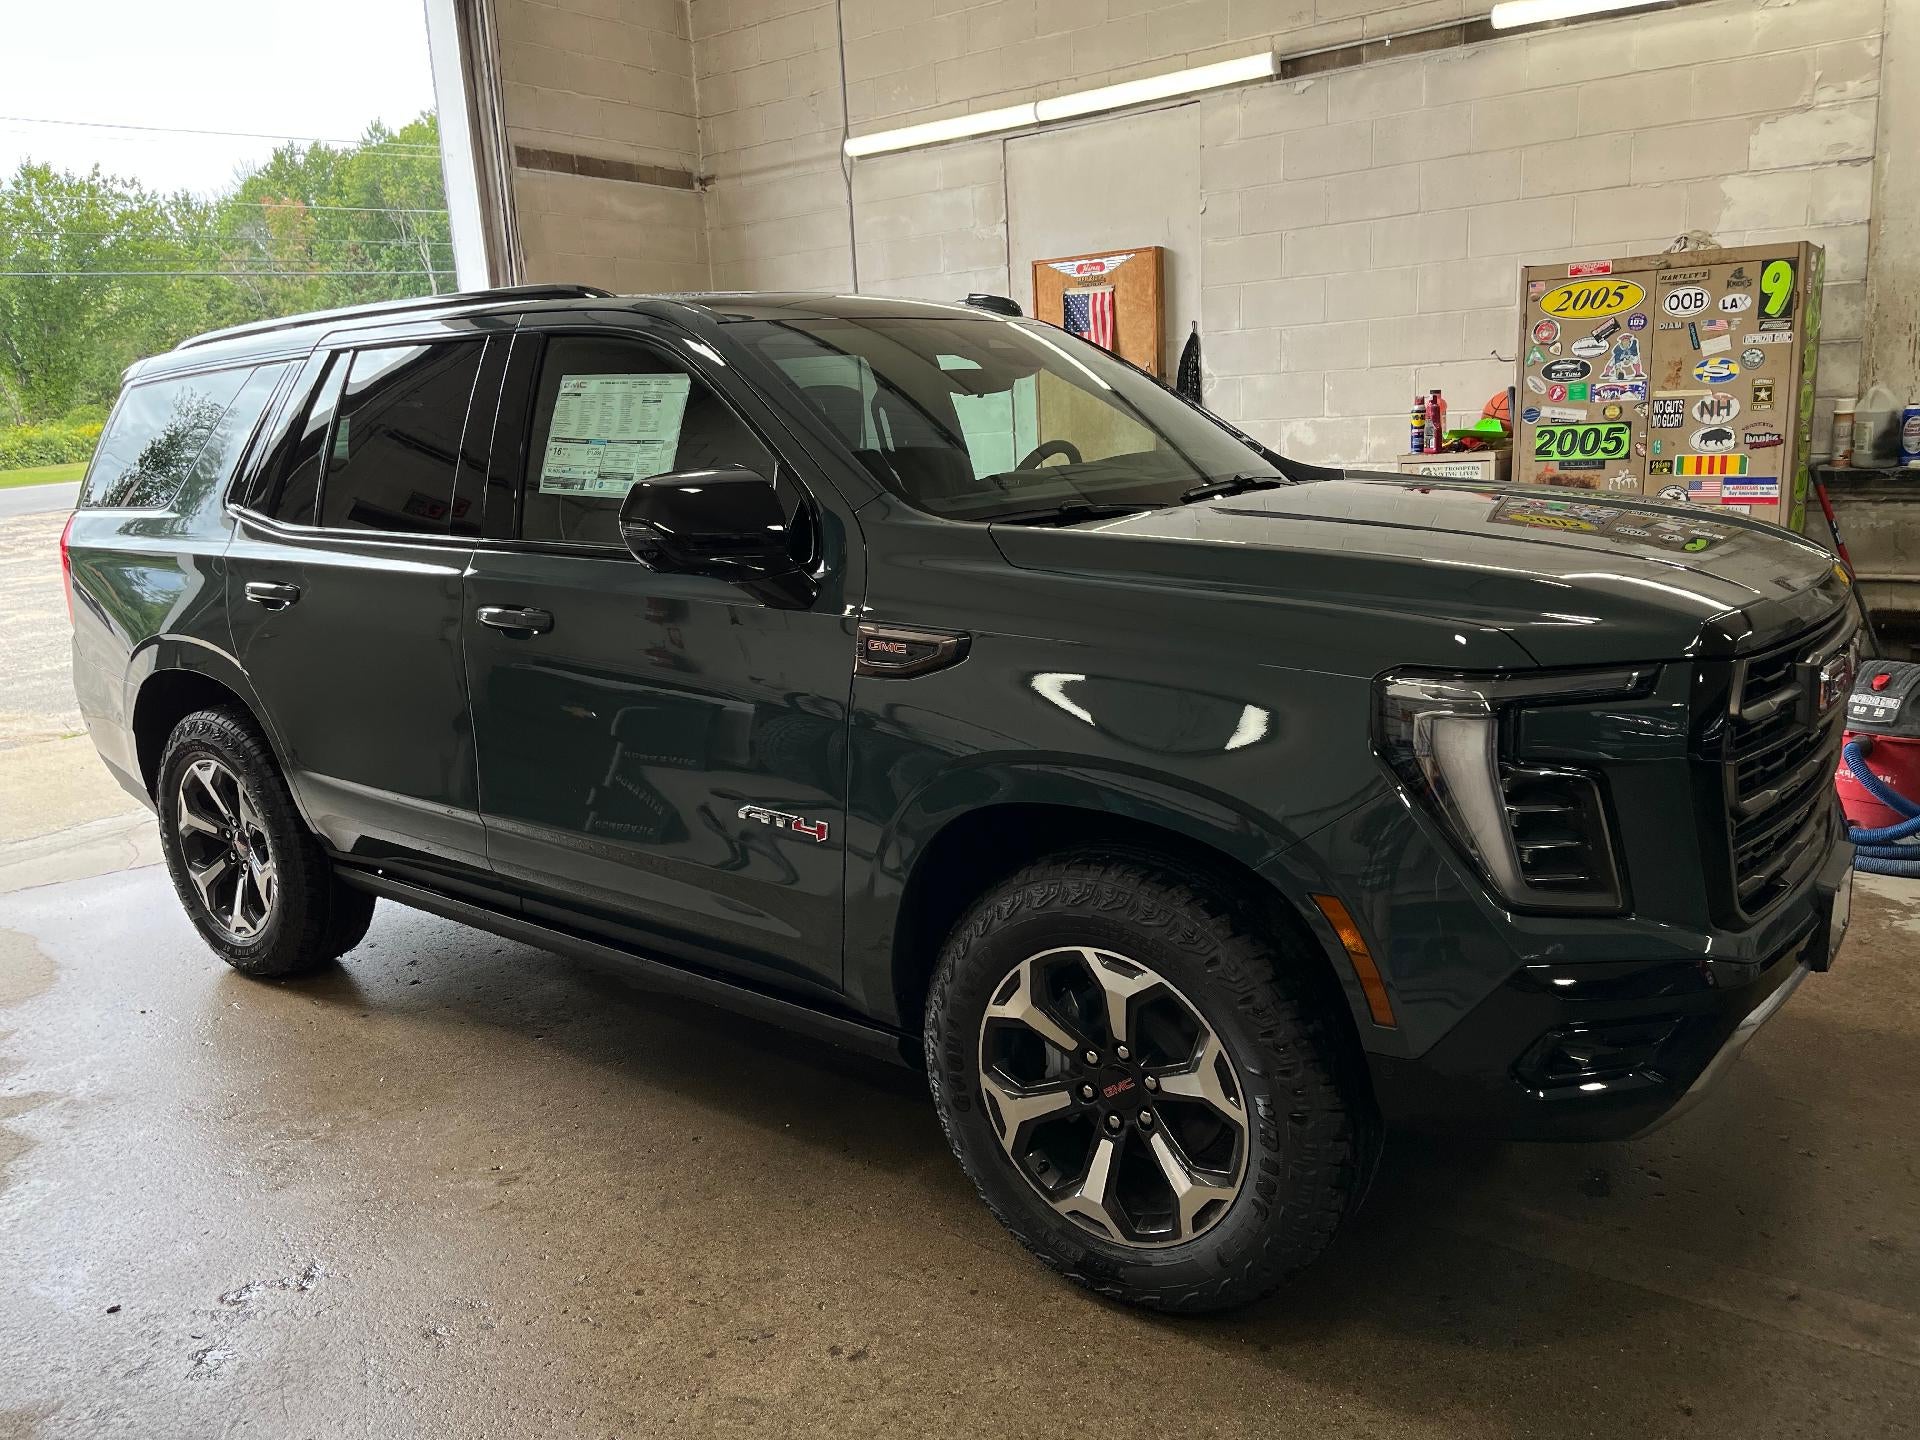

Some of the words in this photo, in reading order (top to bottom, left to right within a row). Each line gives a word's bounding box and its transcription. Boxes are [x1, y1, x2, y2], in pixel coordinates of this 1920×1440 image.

[1552, 285, 1630, 313] 2005
[1761, 260, 1793, 318] 9
[1668, 292, 1705, 311] OOB
[1653, 400, 1664, 413] NO
[1665, 399, 1684, 413] GUTS
[1699, 399, 1731, 417] NH
[1651, 415, 1662, 428] NO
[1662, 413, 1683, 428] GLORY
[1535, 427, 1628, 457] 2005
[867, 639, 907, 654] GMC
[737, 804, 829, 842] AT4
[1103, 1077, 1135, 1098] GMC
